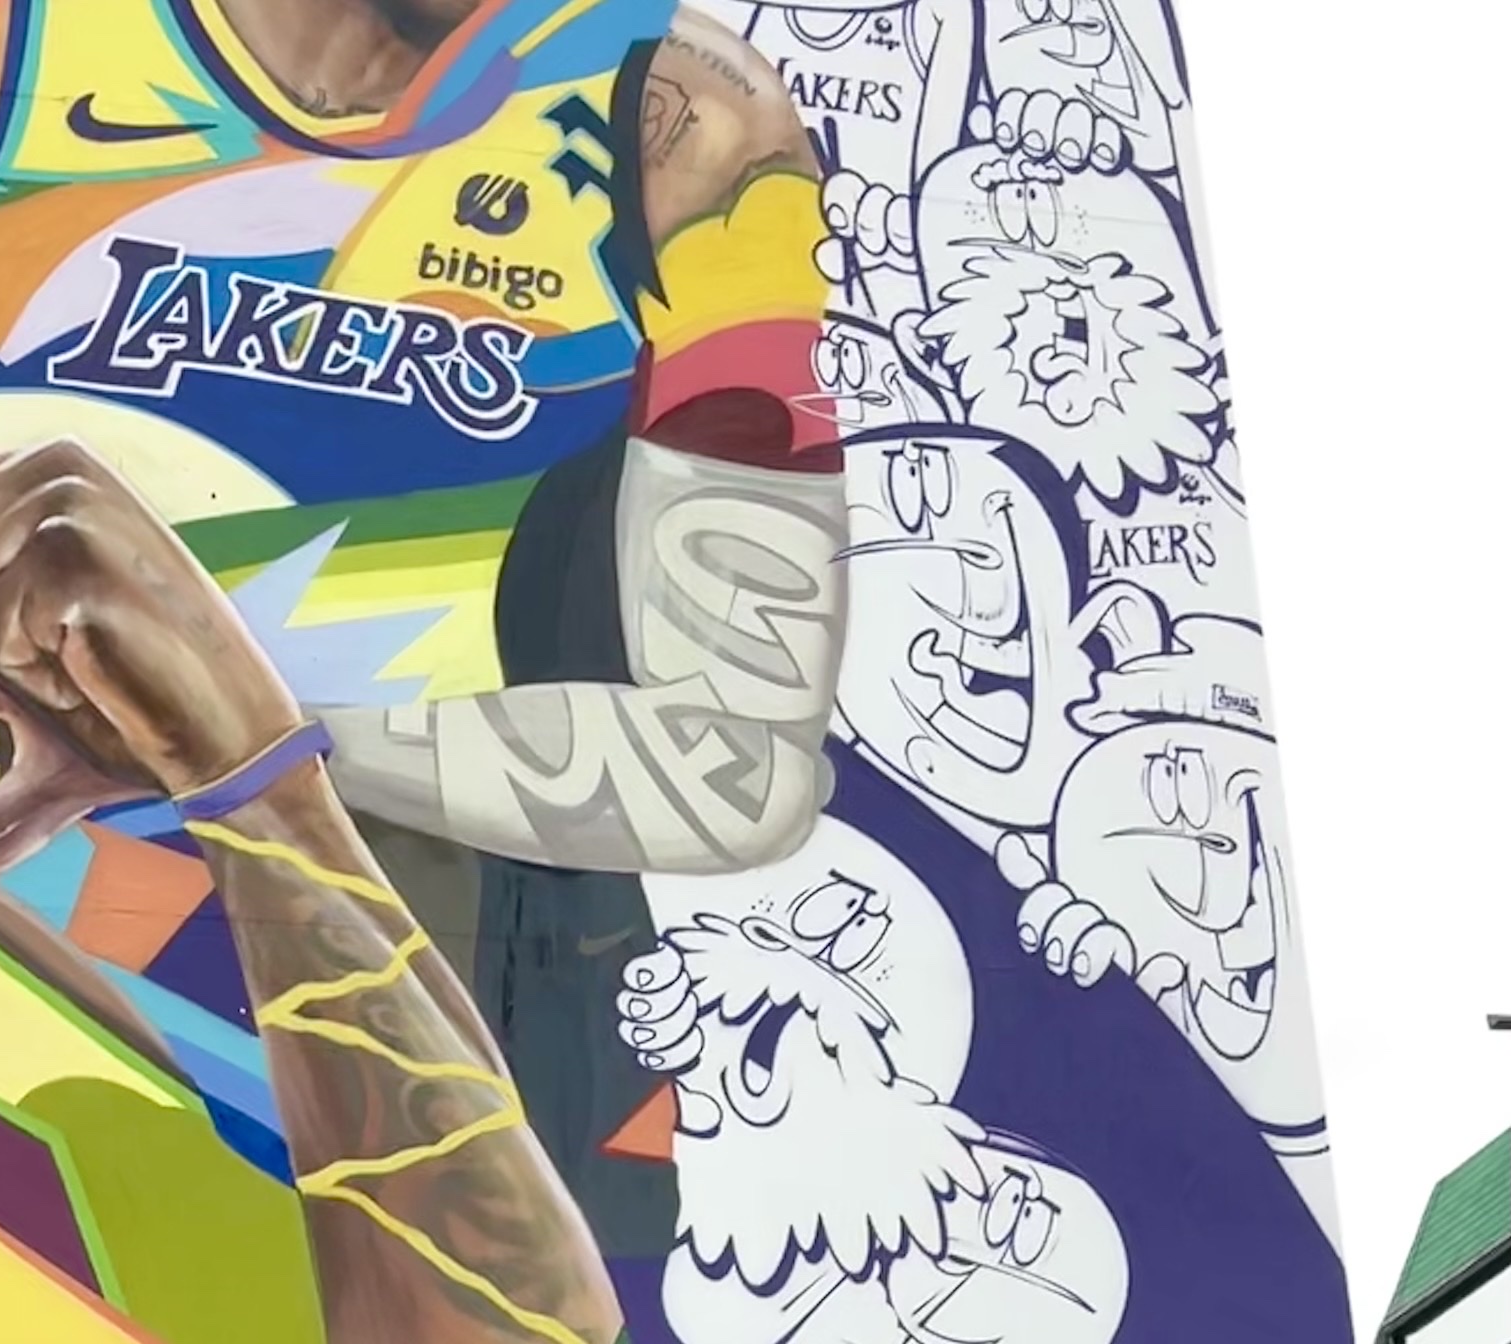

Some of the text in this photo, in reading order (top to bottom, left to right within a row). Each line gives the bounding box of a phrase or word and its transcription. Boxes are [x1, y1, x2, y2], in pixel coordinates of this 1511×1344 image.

[419, 242, 563, 311] bibigo
[47, 236, 539, 441] LAKERS
[1083, 519, 1217, 586] LAKERS
